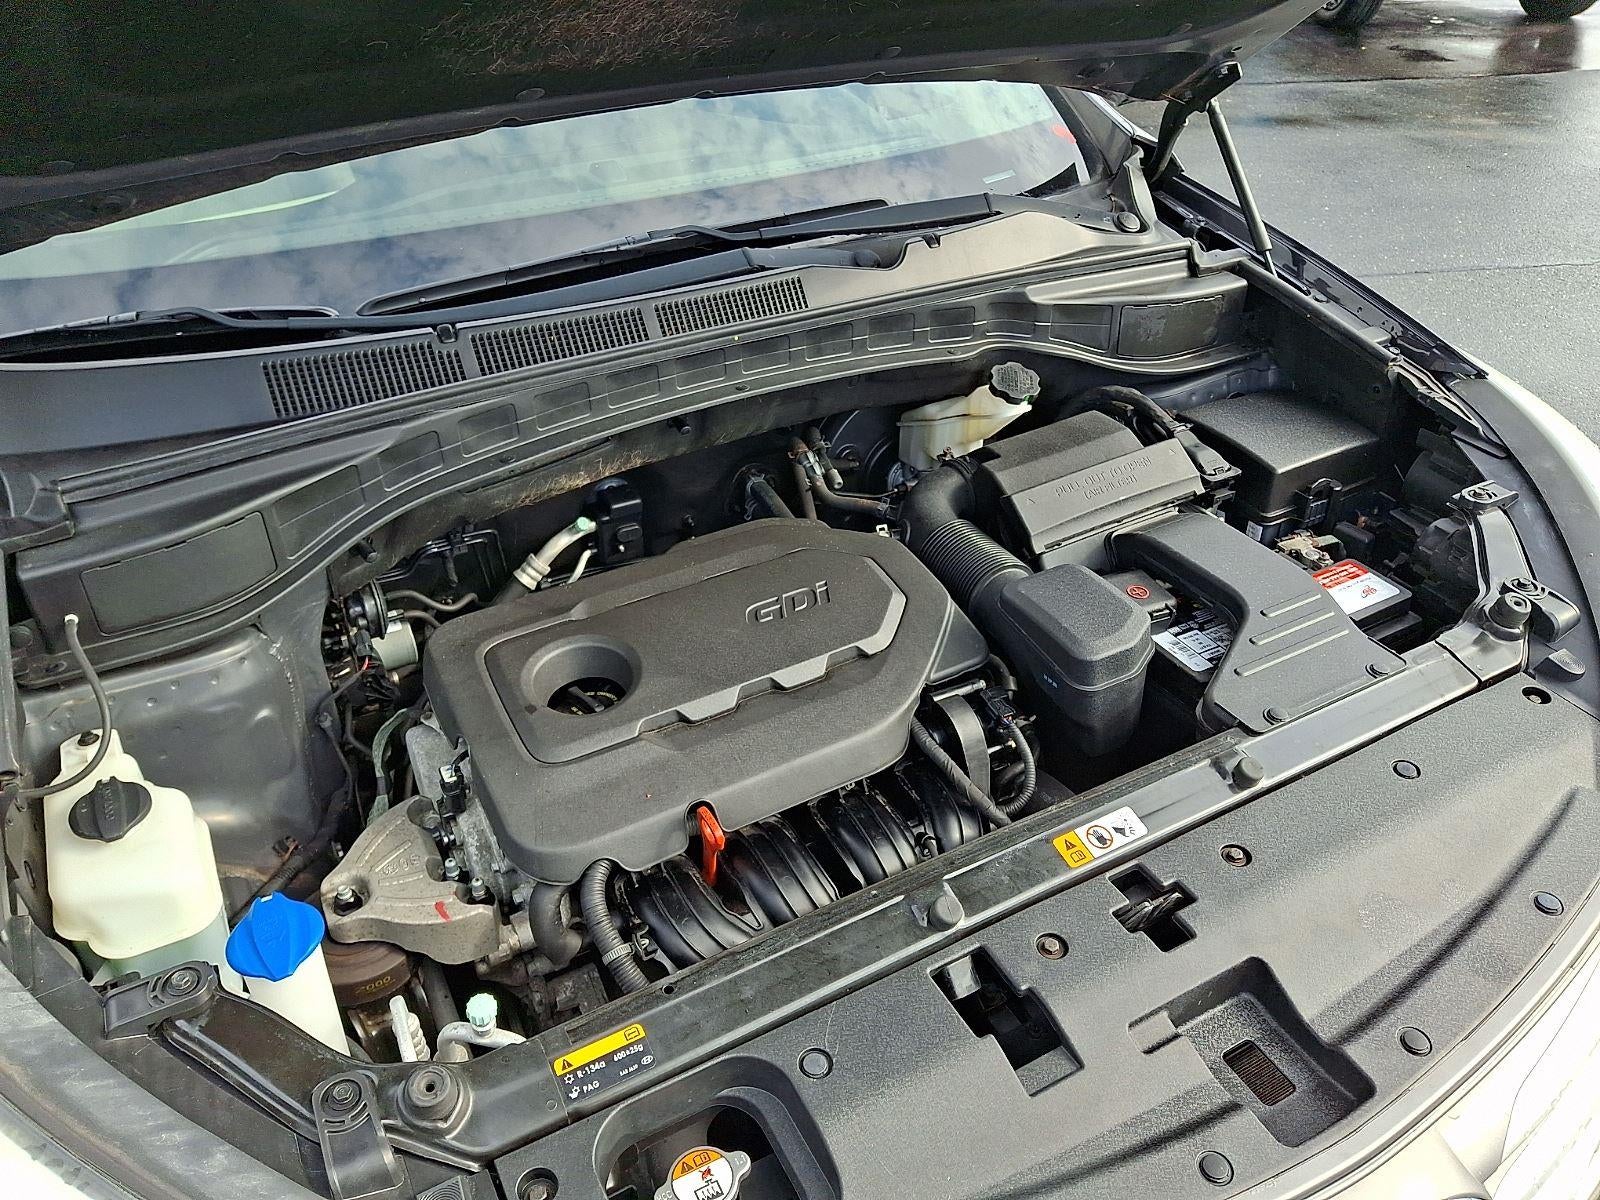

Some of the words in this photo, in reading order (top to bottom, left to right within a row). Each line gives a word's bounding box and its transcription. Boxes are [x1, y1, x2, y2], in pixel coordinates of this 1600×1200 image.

[745, 580, 831, 624] GDi
[576, 1060, 606, 1079] R-134a
[582, 1080, 600, 1094] PAG
